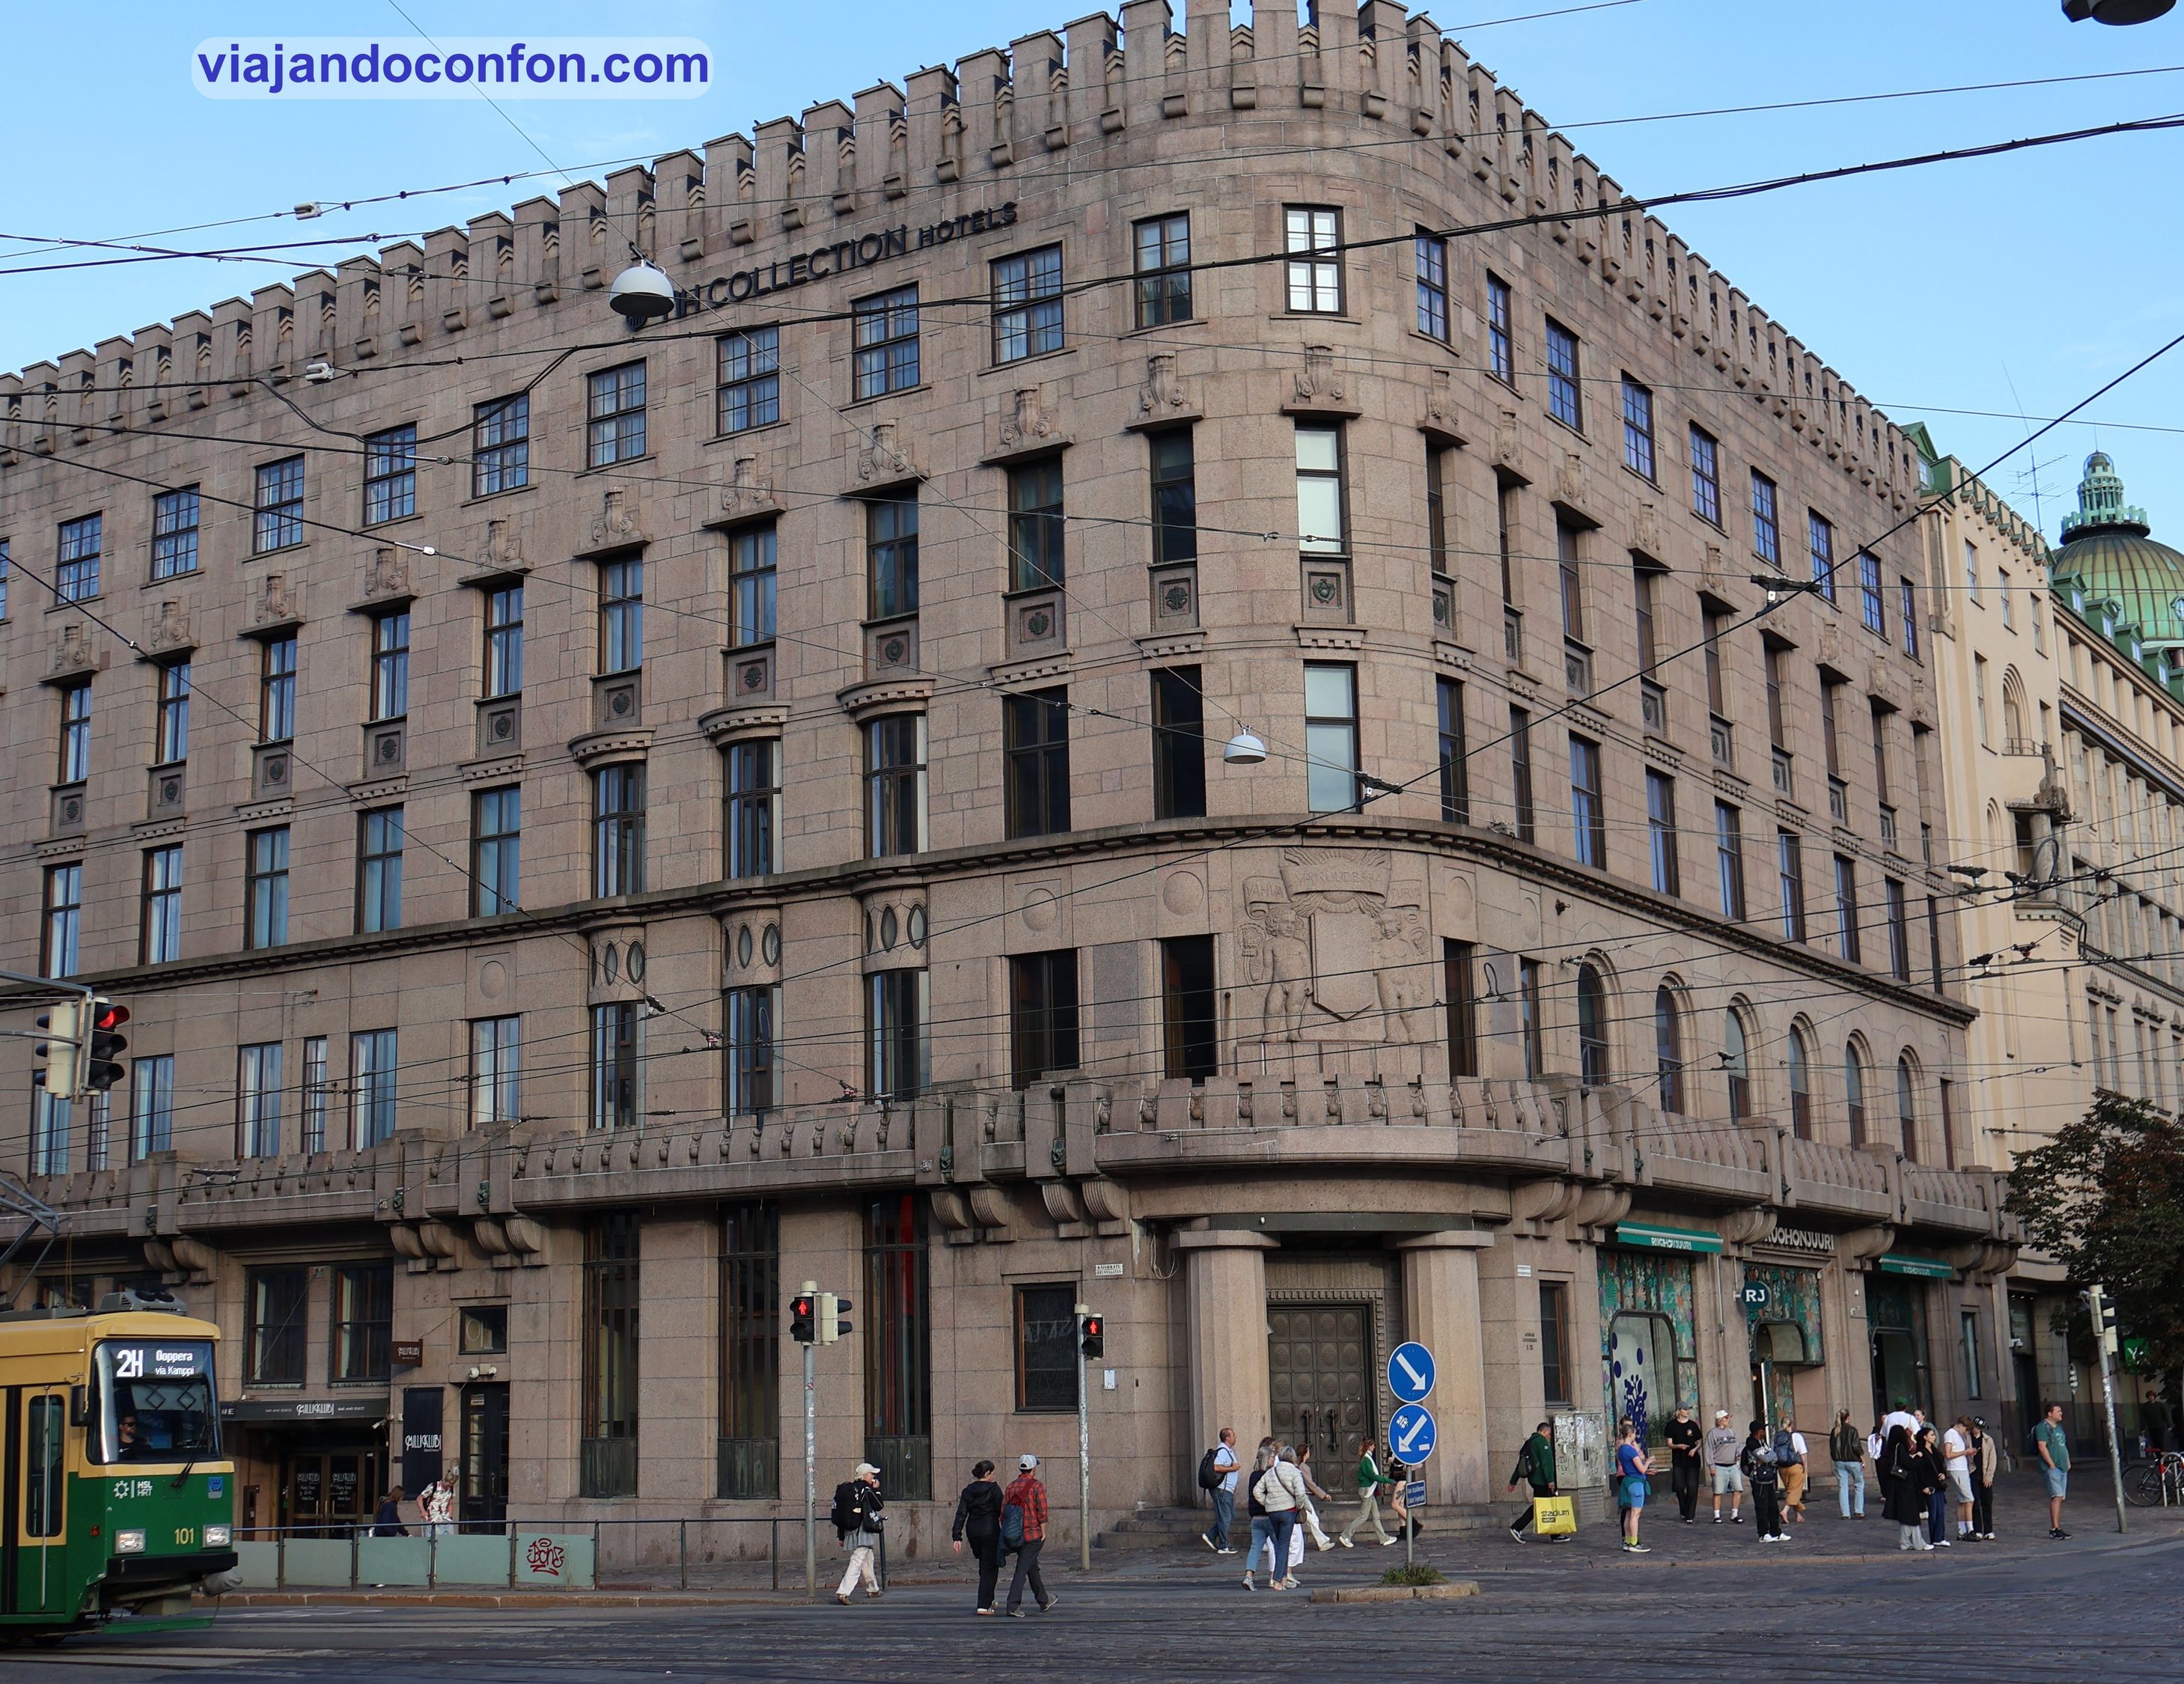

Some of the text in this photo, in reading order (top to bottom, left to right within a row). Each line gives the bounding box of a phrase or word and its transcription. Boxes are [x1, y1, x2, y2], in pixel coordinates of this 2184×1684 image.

[707, 224, 908, 308] COLLECTION
[918, 201, 1019, 248] HOTELS
[1745, 1289, 1765, 1302] RJ
[116, 1349, 144, 1377] 2H
[156, 1349, 193, 1363] Ooppera
[155, 1366, 195, 1376] via Kamppi
[138, 1488, 153, 1496] HRT
[174, 1528, 195, 1545] 101
